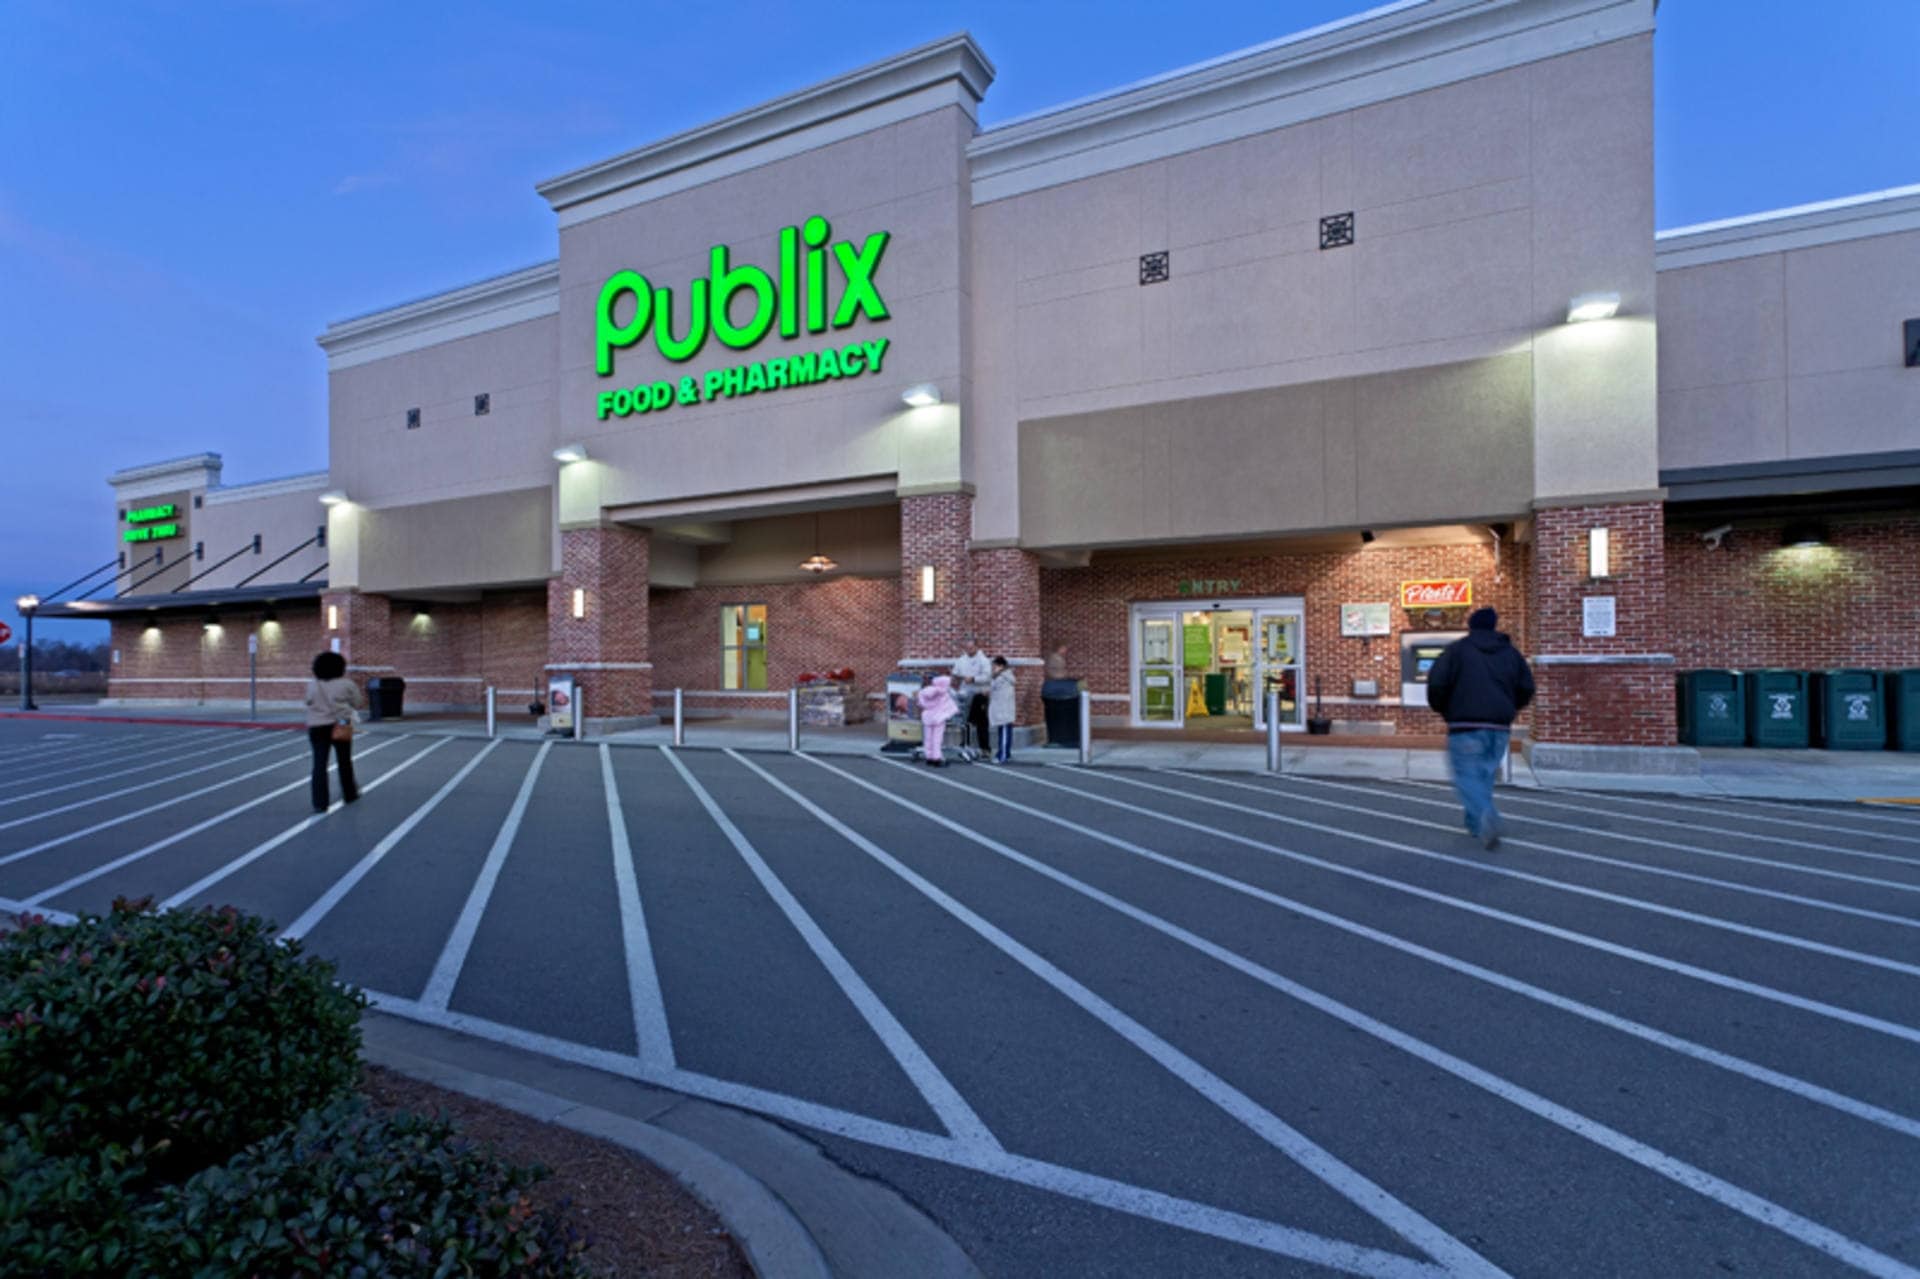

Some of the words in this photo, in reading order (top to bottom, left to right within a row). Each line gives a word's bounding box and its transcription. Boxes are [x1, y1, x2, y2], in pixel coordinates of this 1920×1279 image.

[597, 381, 674, 420] FOOD
[676, 375, 699, 406] &
[703, 337, 889, 401] PHARMACY
[1179, 579, 1242, 593] NTRY
